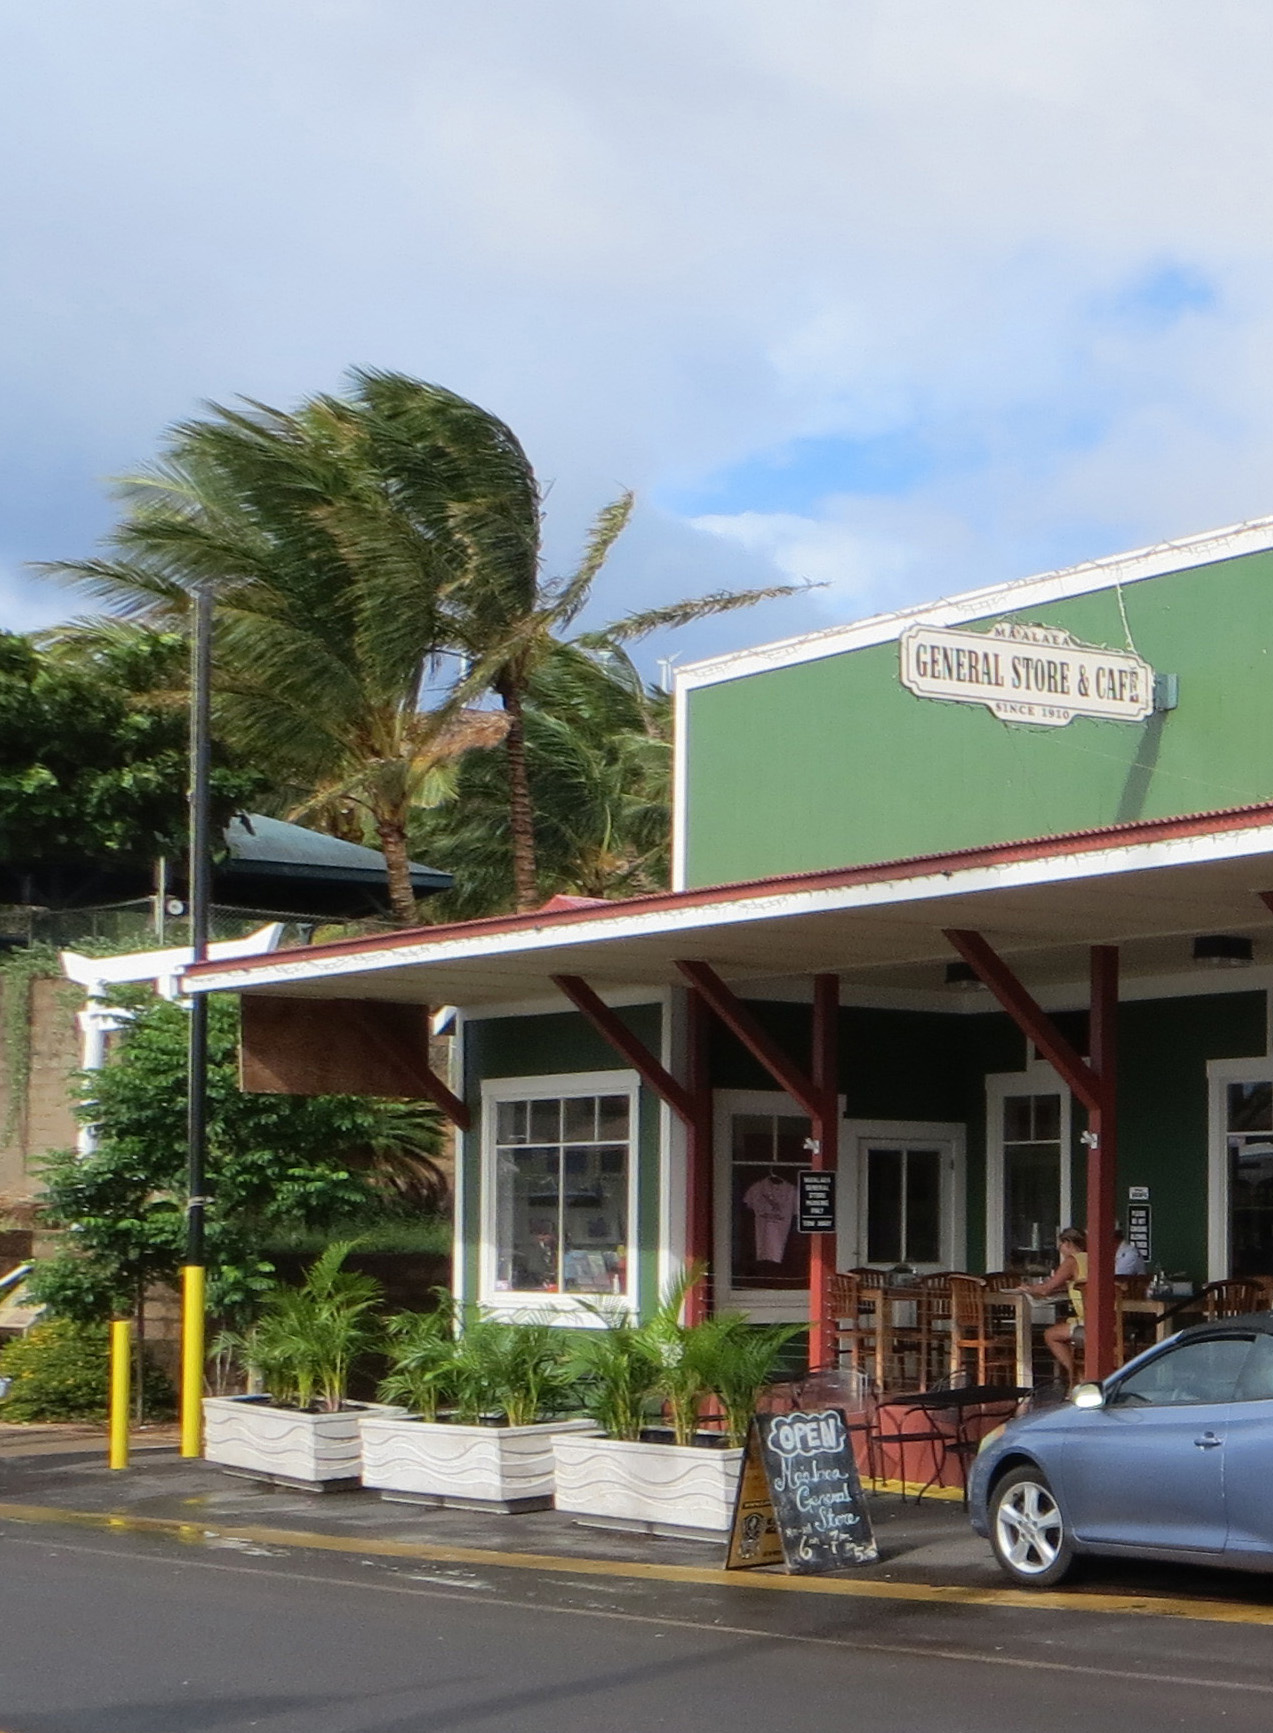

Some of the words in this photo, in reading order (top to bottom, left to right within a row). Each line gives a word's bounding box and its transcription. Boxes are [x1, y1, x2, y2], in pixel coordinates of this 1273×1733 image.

[916, 643, 1004, 687] GENERAL
[1011, 655, 1070, 695] STORE
[1077, 664, 1090, 697] &
[995, 702, 1035, 716] SINCE
[1041, 708, 1070, 720] 1910
[780, 1418, 837, 1450] OPEN
[796, 1482, 852, 1513] General
[814, 1505, 860, 1532] Store
